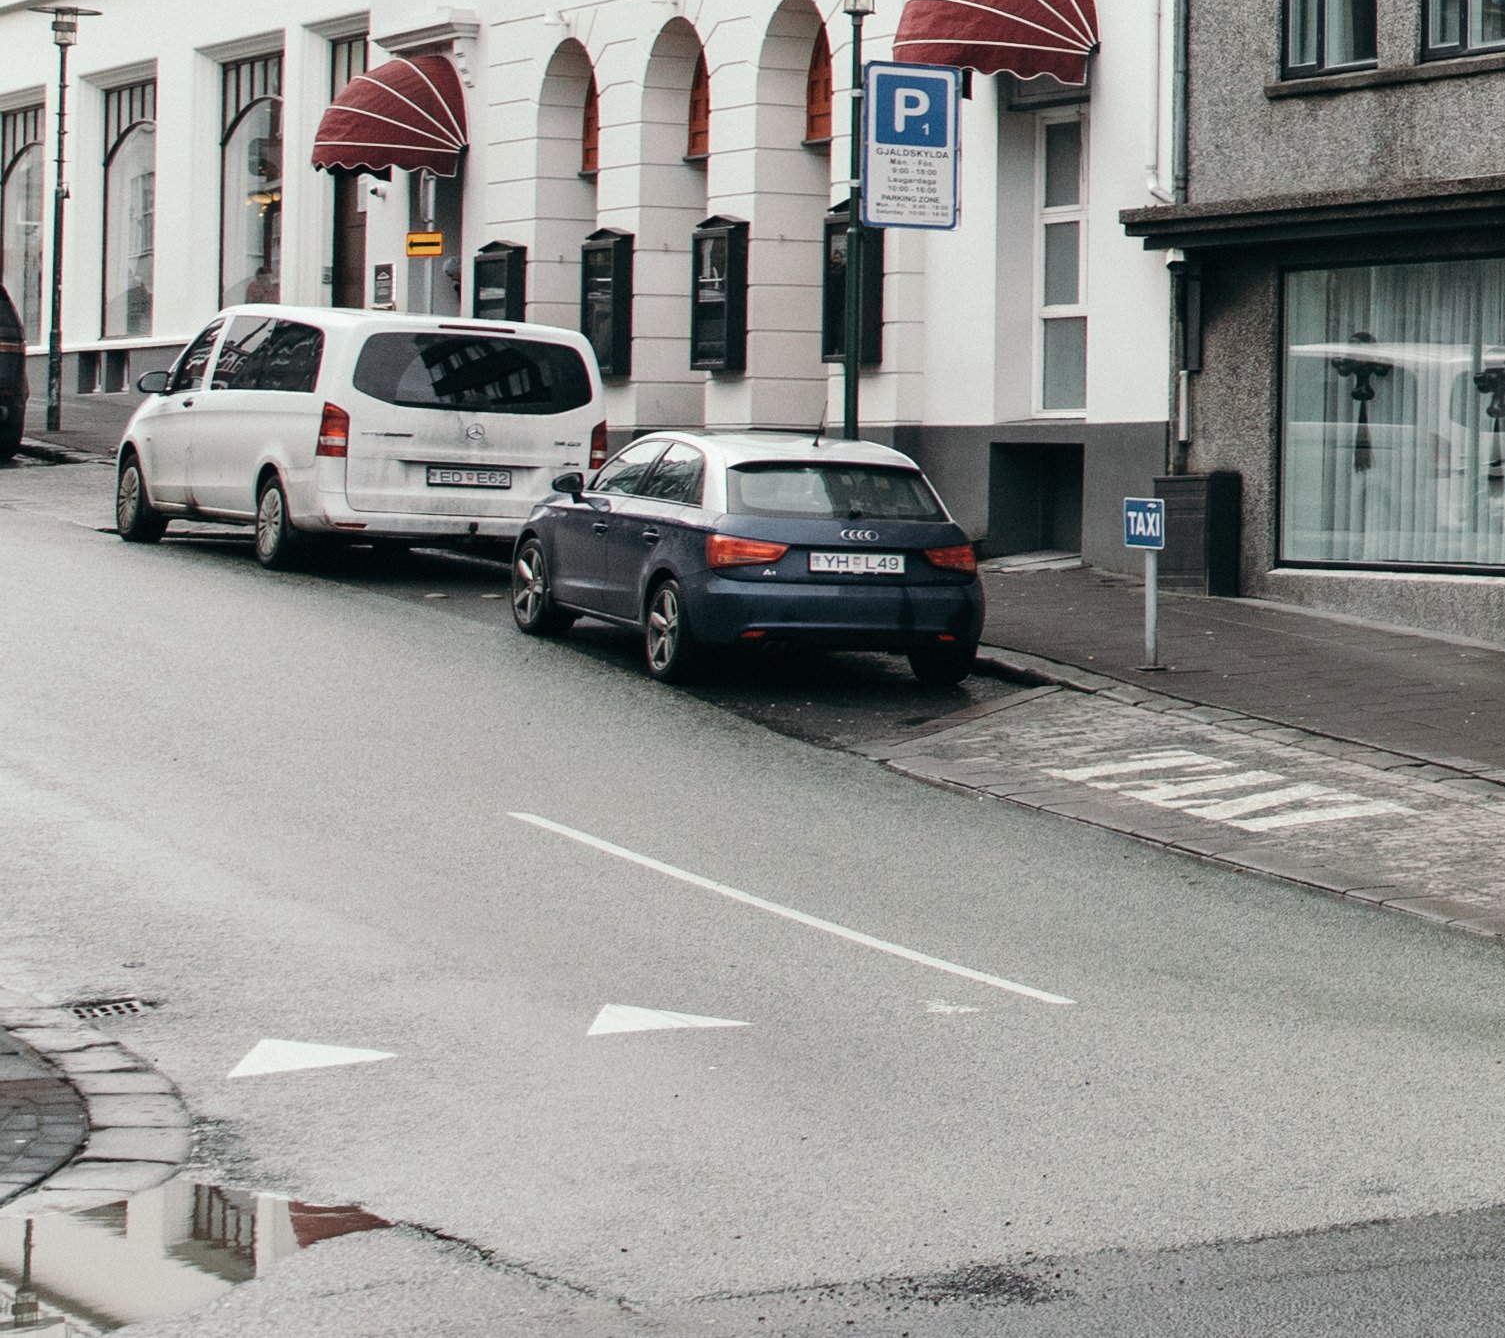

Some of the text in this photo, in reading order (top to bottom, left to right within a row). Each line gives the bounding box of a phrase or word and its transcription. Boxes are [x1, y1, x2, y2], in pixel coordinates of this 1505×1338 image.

[894, 87, 931, 134] P
[876, 147, 950, 159] GJALDSKYLDA
[881, 194, 941, 204] PARKING ZONE
[440, 471, 508, 484] ED E62
[1127, 511, 1161, 537] TAXI
[824, 556, 899, 571] YH L49
